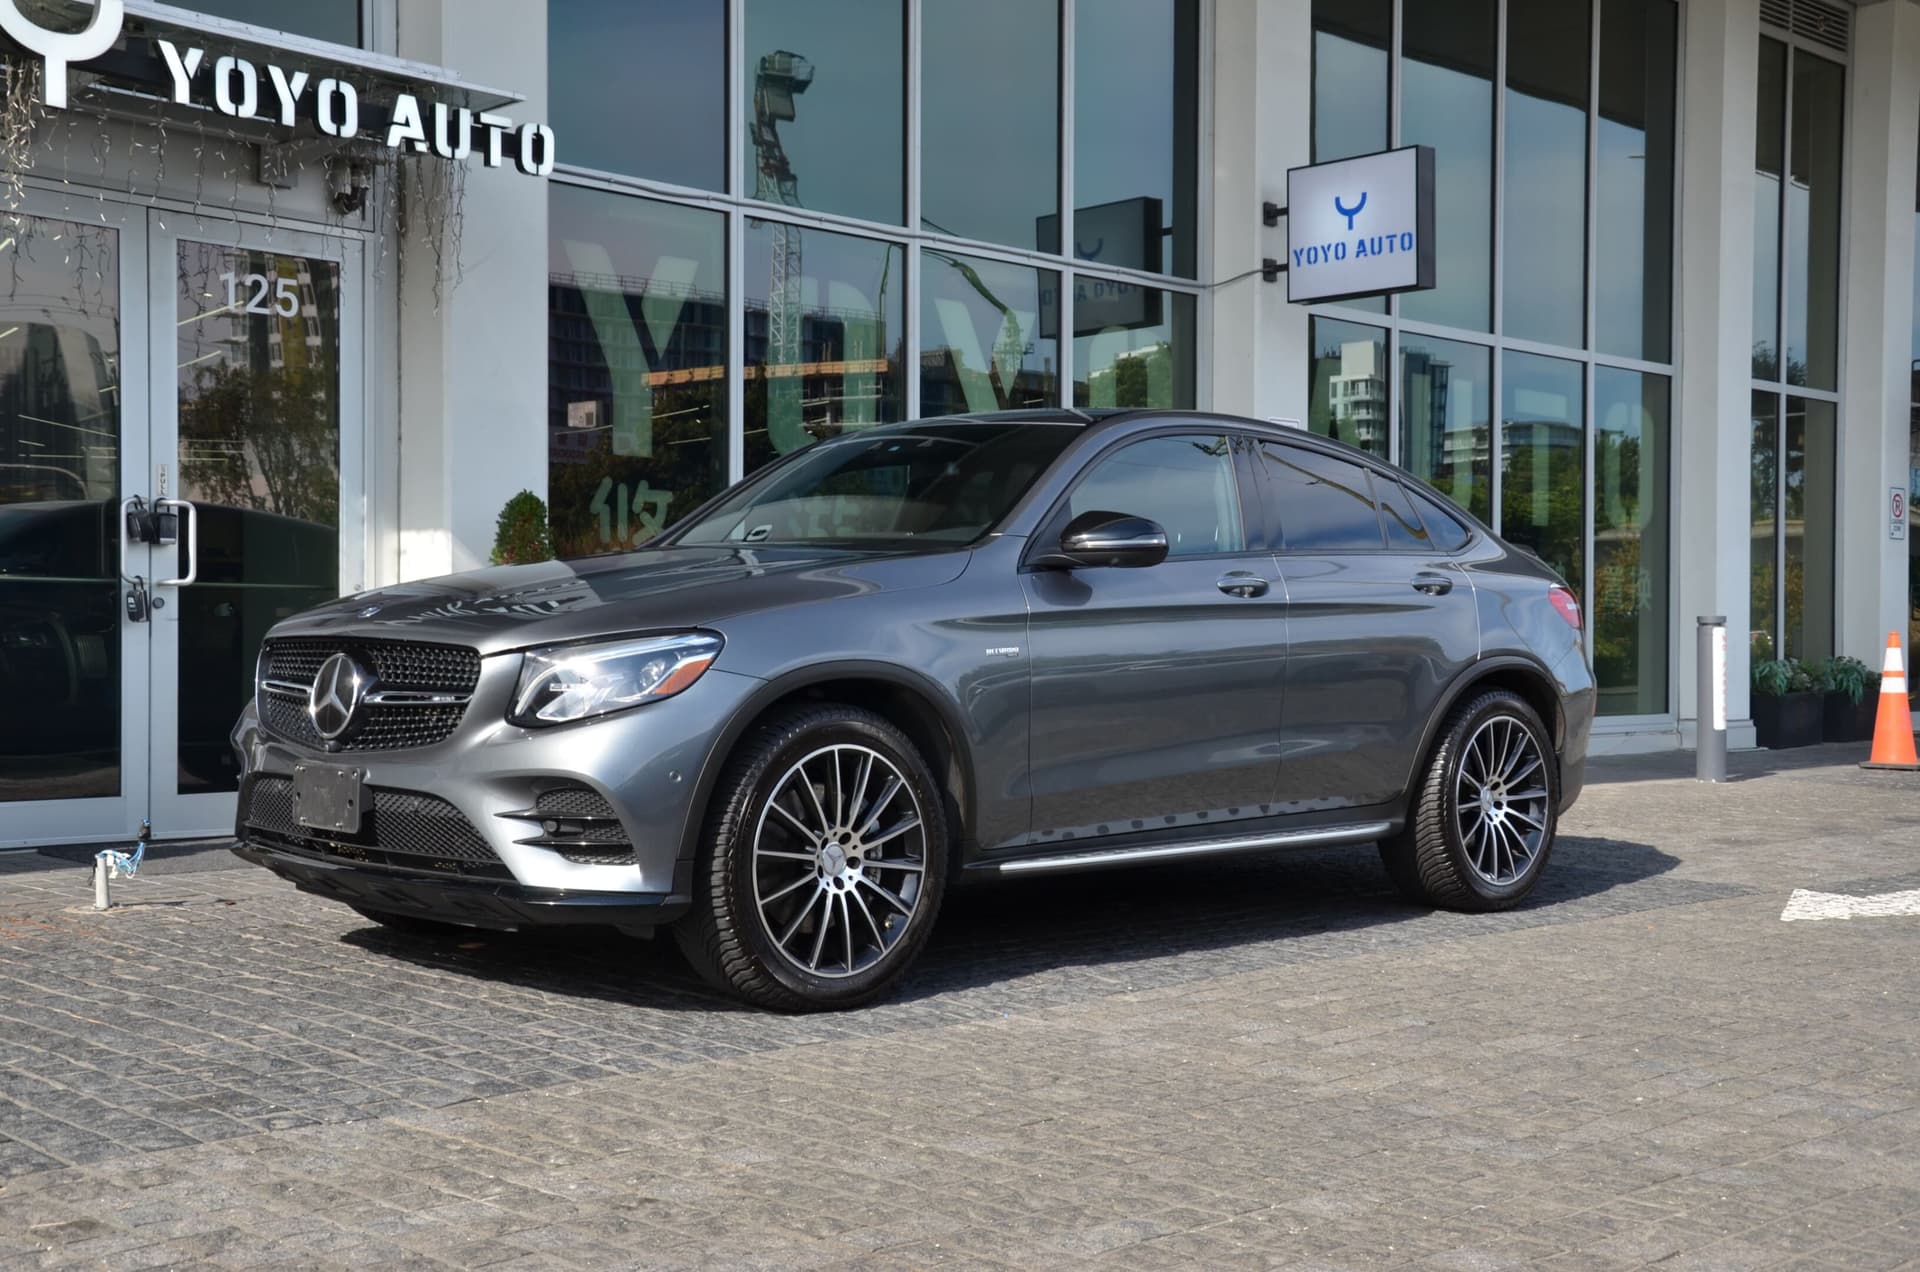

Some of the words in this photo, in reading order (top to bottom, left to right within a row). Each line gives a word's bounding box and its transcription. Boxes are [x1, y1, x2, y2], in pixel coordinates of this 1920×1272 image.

[157, 39, 359, 138] YOYO
[387, 94, 555, 176] AUTO
[1293, 241, 1346, 267] YOYO
[1355, 232, 1414, 258] AUTO
[219, 271, 299, 318] 125
